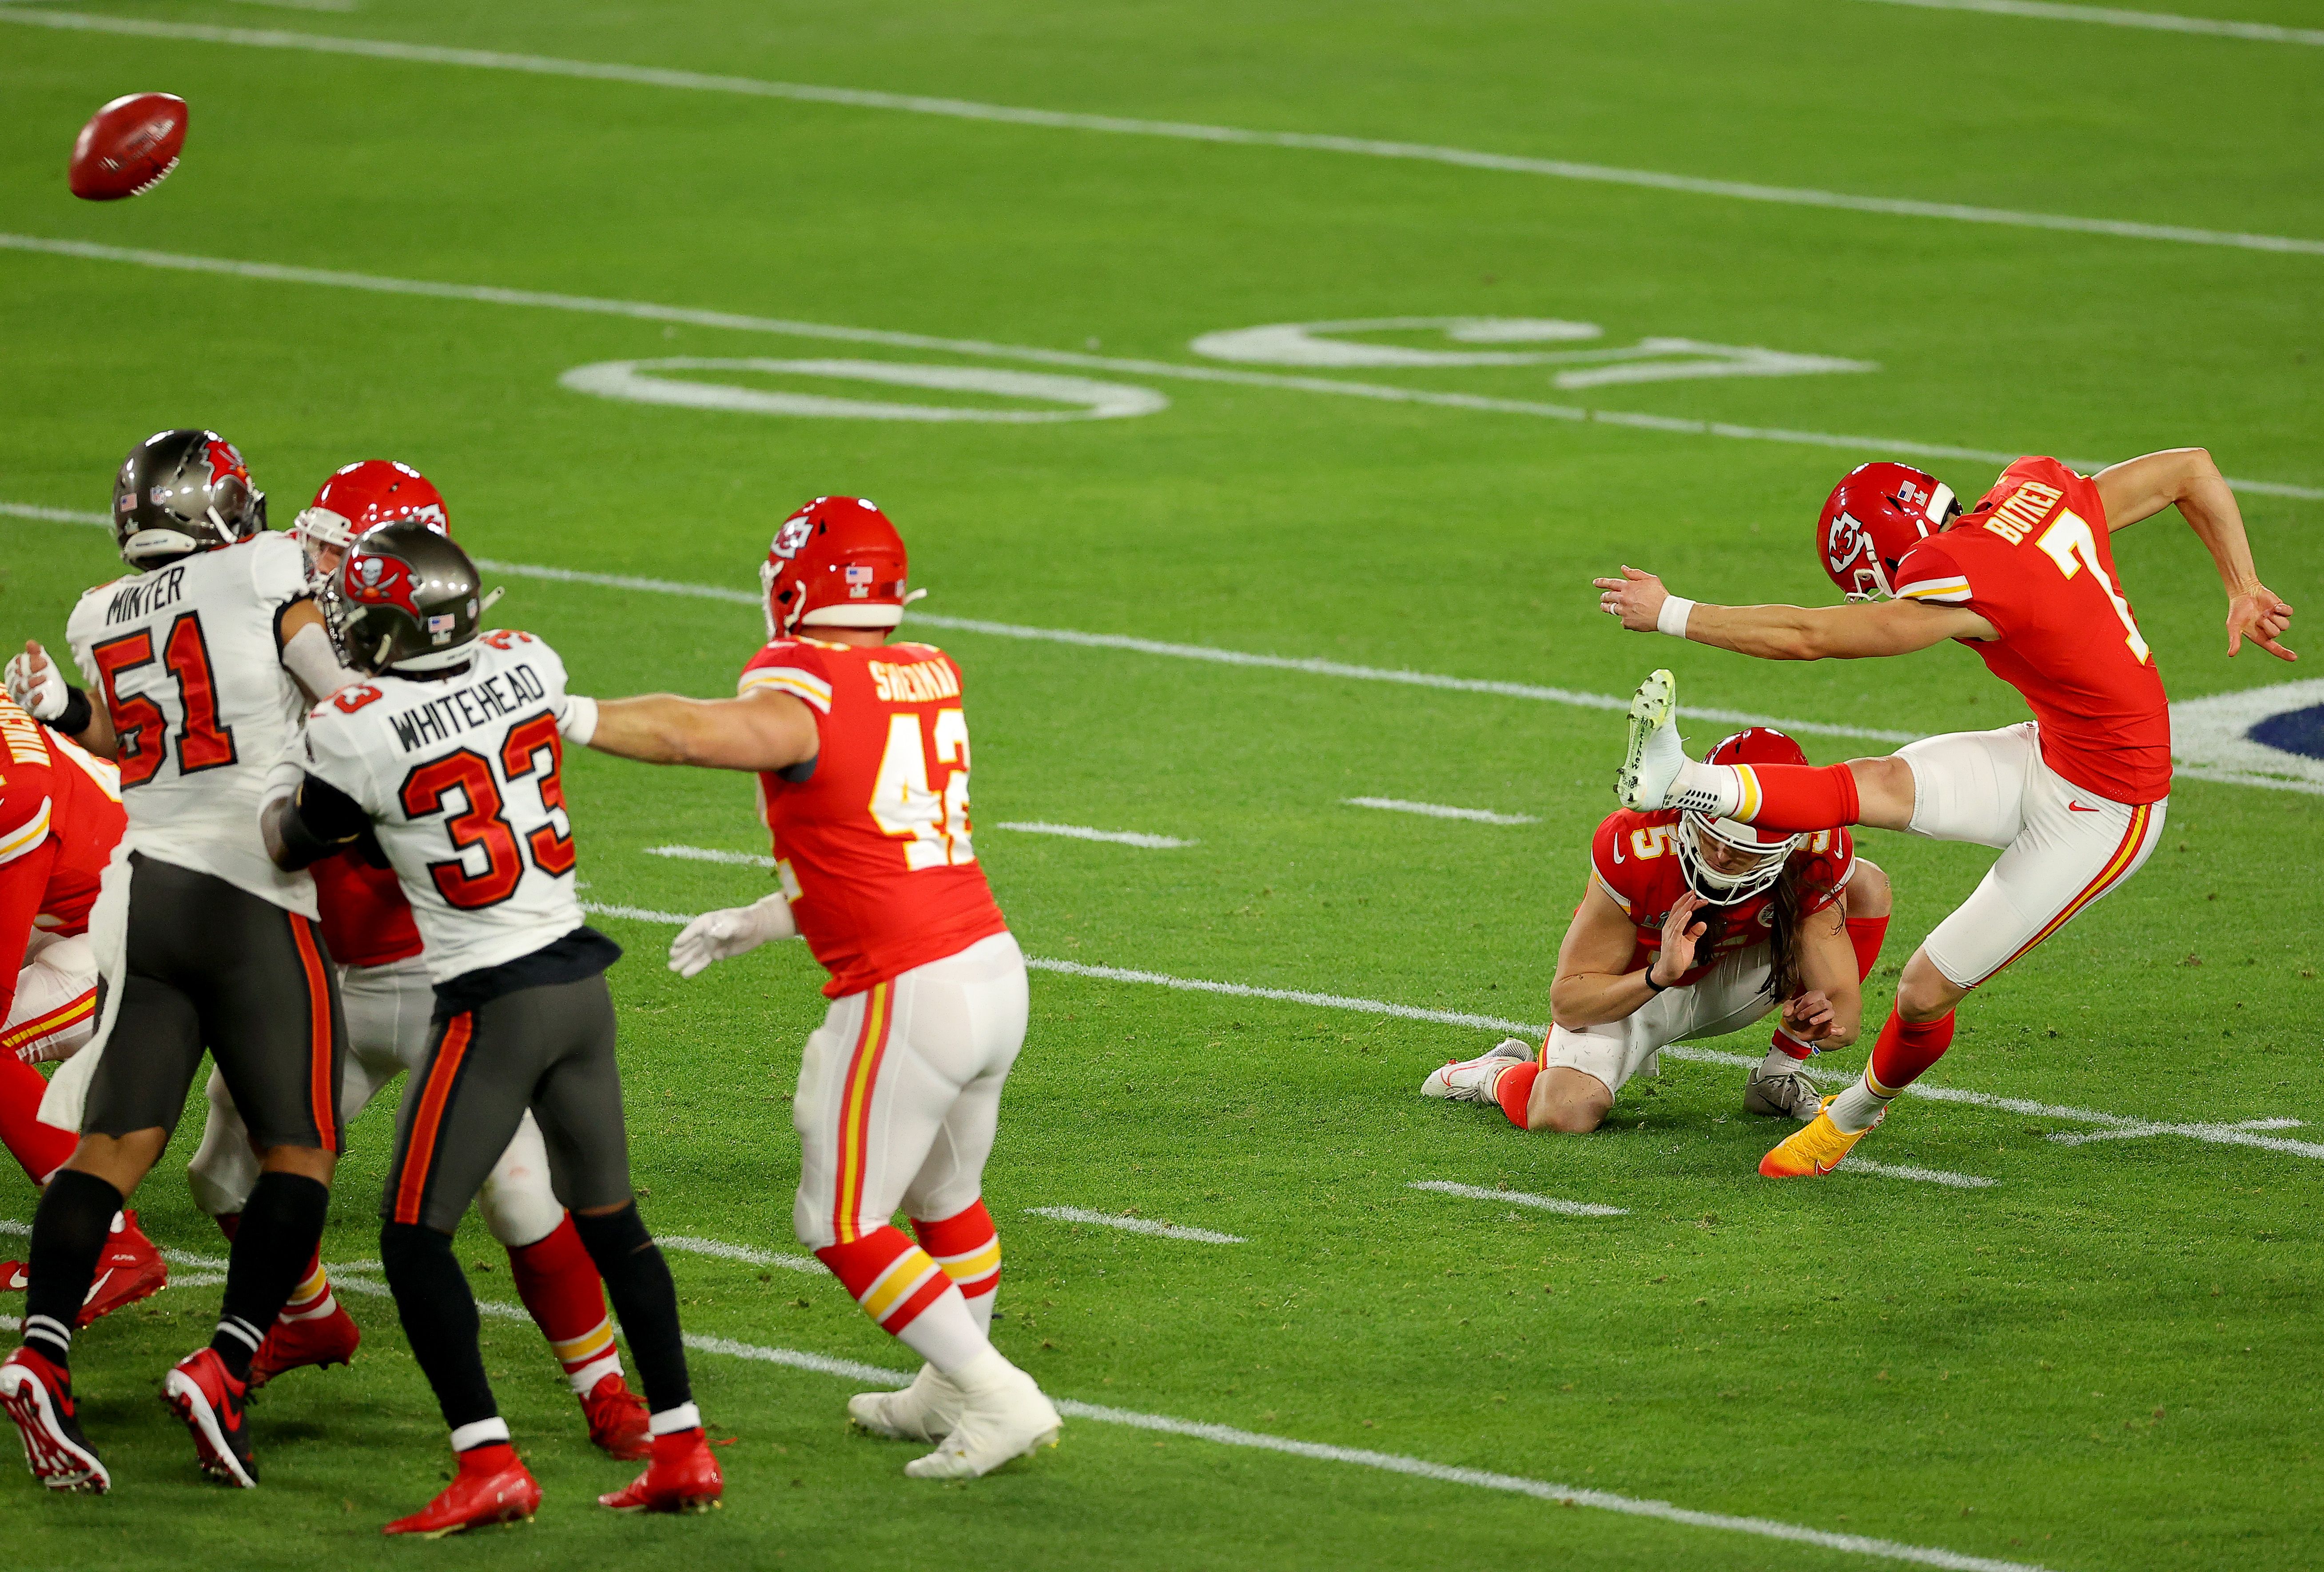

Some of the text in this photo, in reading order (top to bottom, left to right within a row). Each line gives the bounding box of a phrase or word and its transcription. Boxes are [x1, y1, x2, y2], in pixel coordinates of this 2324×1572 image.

[1983, 480, 2065, 546] BUTKER
[106, 566, 186, 626] MINTER
[2034, 507, 2150, 666] 7
[92, 610, 238, 790] 51
[389, 663, 545, 753] WHITEHEAD
[868, 657, 960, 703] SHERMA
[1632, 715, 1649, 770] Matthew
[398, 708, 577, 910] 33
[868, 707, 976, 872] 42
[1630, 823, 1678, 861] 5
